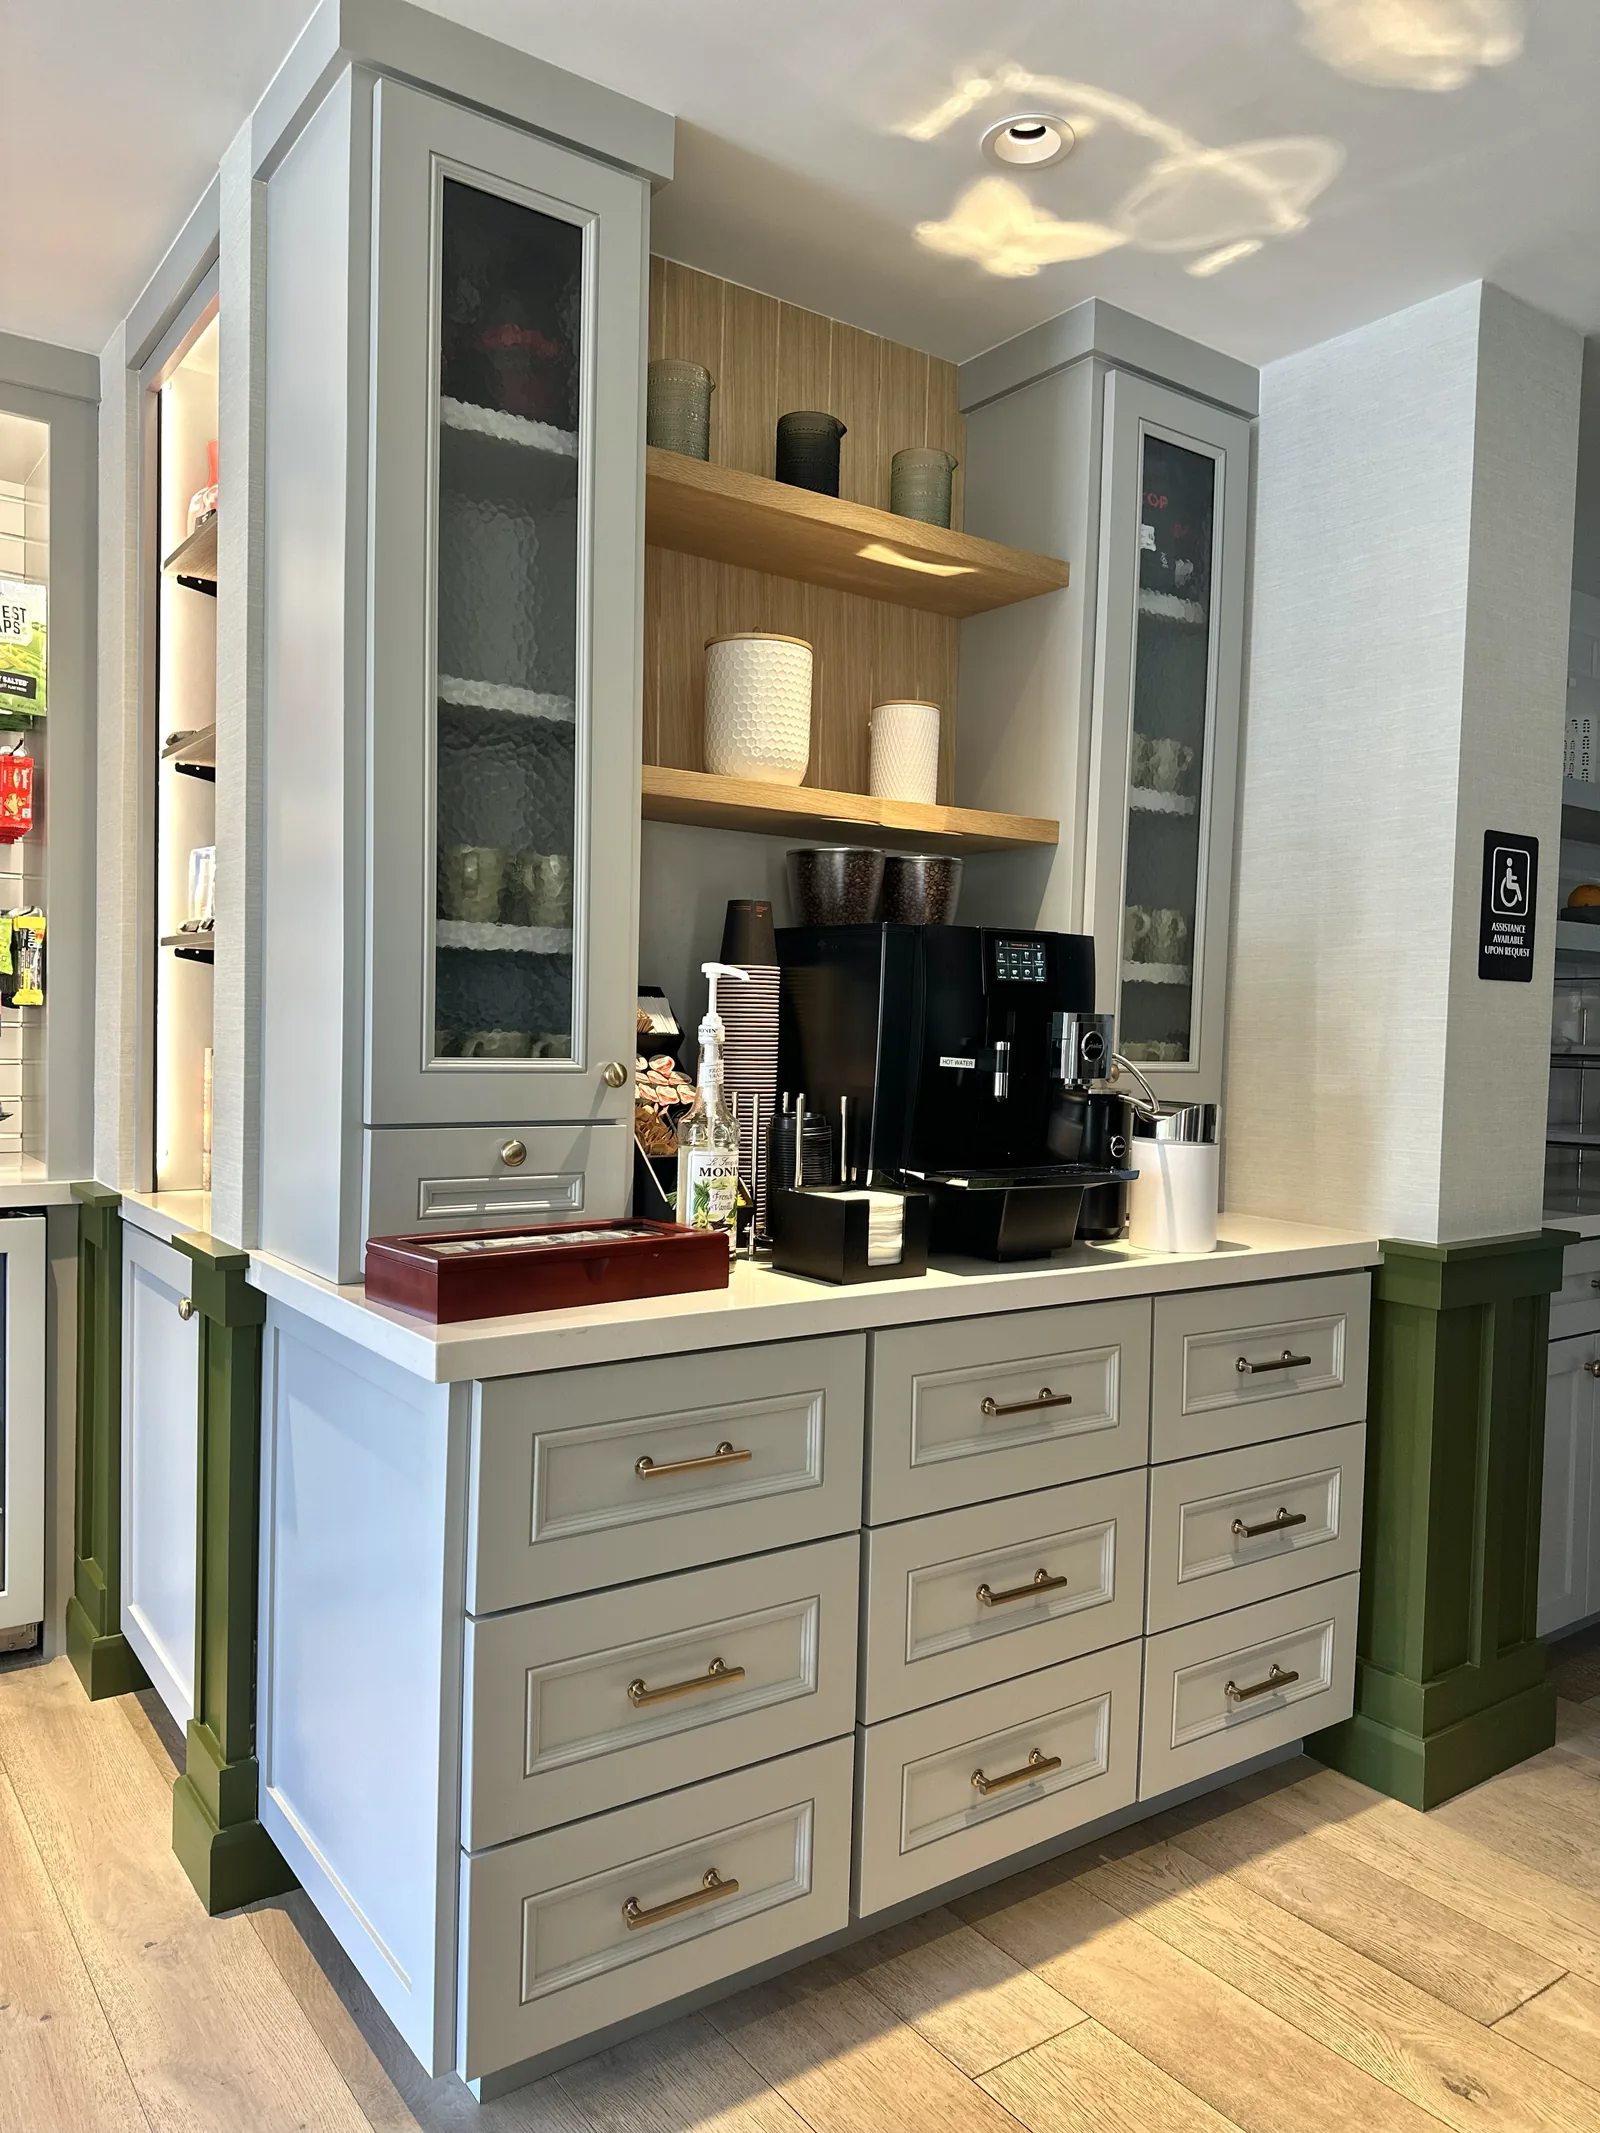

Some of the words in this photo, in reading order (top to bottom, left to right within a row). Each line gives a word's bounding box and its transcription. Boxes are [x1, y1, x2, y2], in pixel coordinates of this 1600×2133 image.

[1492, 922, 1526, 933] ASSISTANCE
[28, 928, 36, 948] KIND
[1493, 934, 1524, 945] AVAILABLE
[1485, 945, 1504, 954] UPON
[1505, 947, 1530, 958] REQUEST
